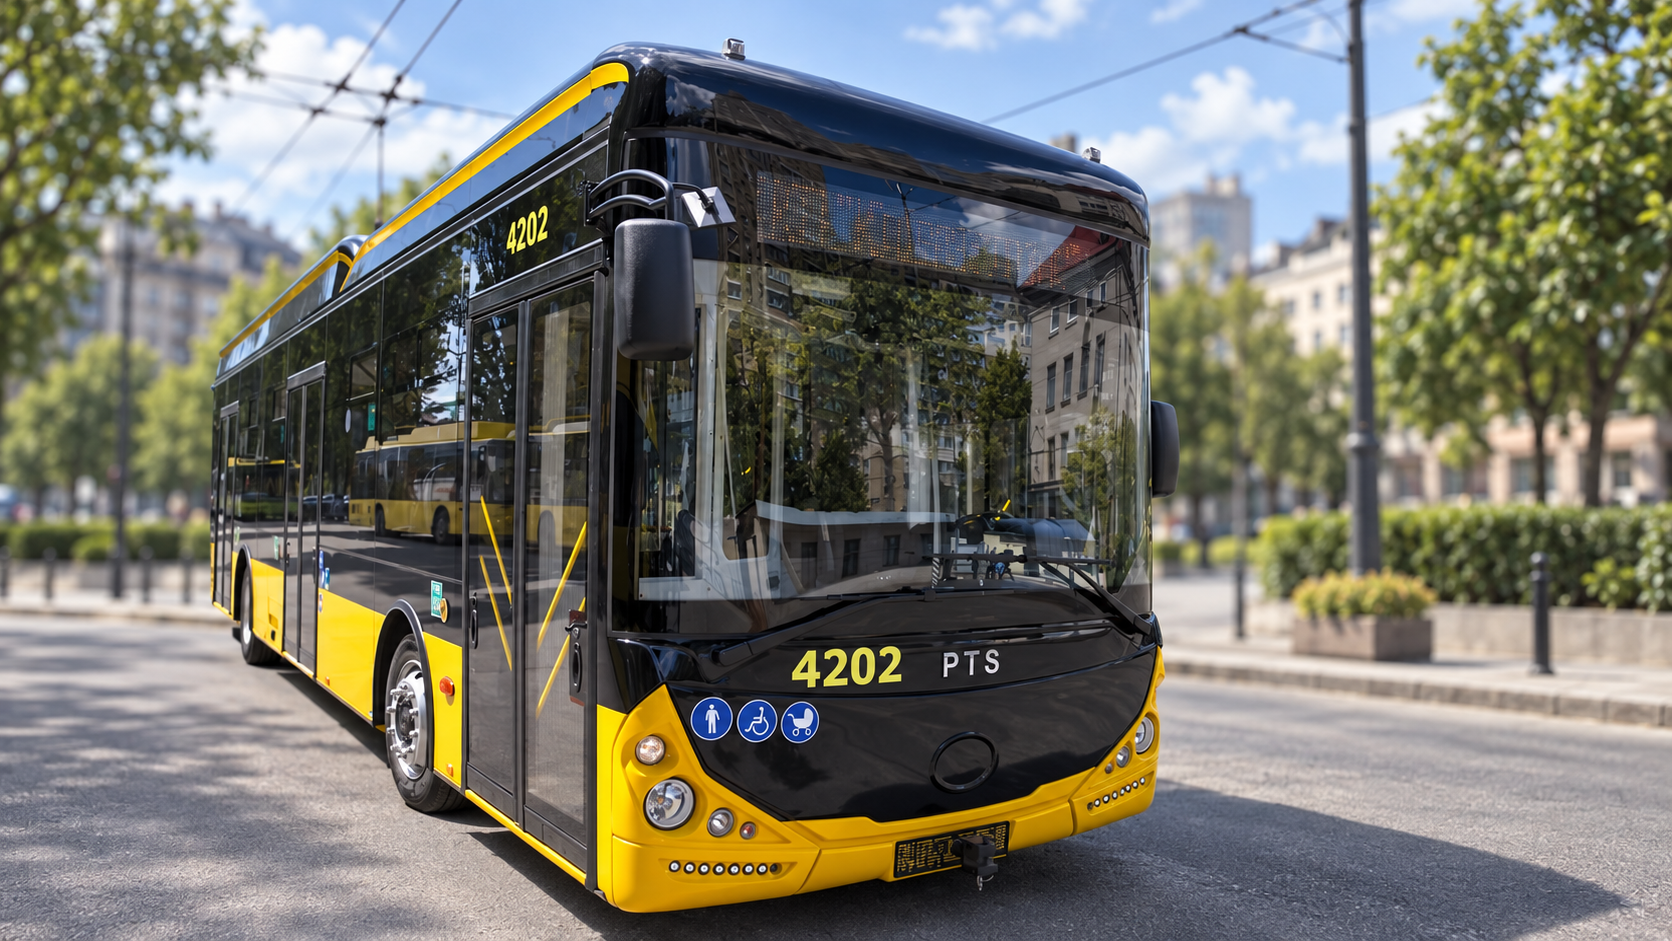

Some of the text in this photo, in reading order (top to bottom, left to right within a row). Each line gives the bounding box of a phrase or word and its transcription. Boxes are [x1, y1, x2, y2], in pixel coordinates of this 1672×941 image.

[506, 205, 549, 255] 4202
[791, 645, 902, 688] 4202
[943, 649, 1000, 678] PTS
